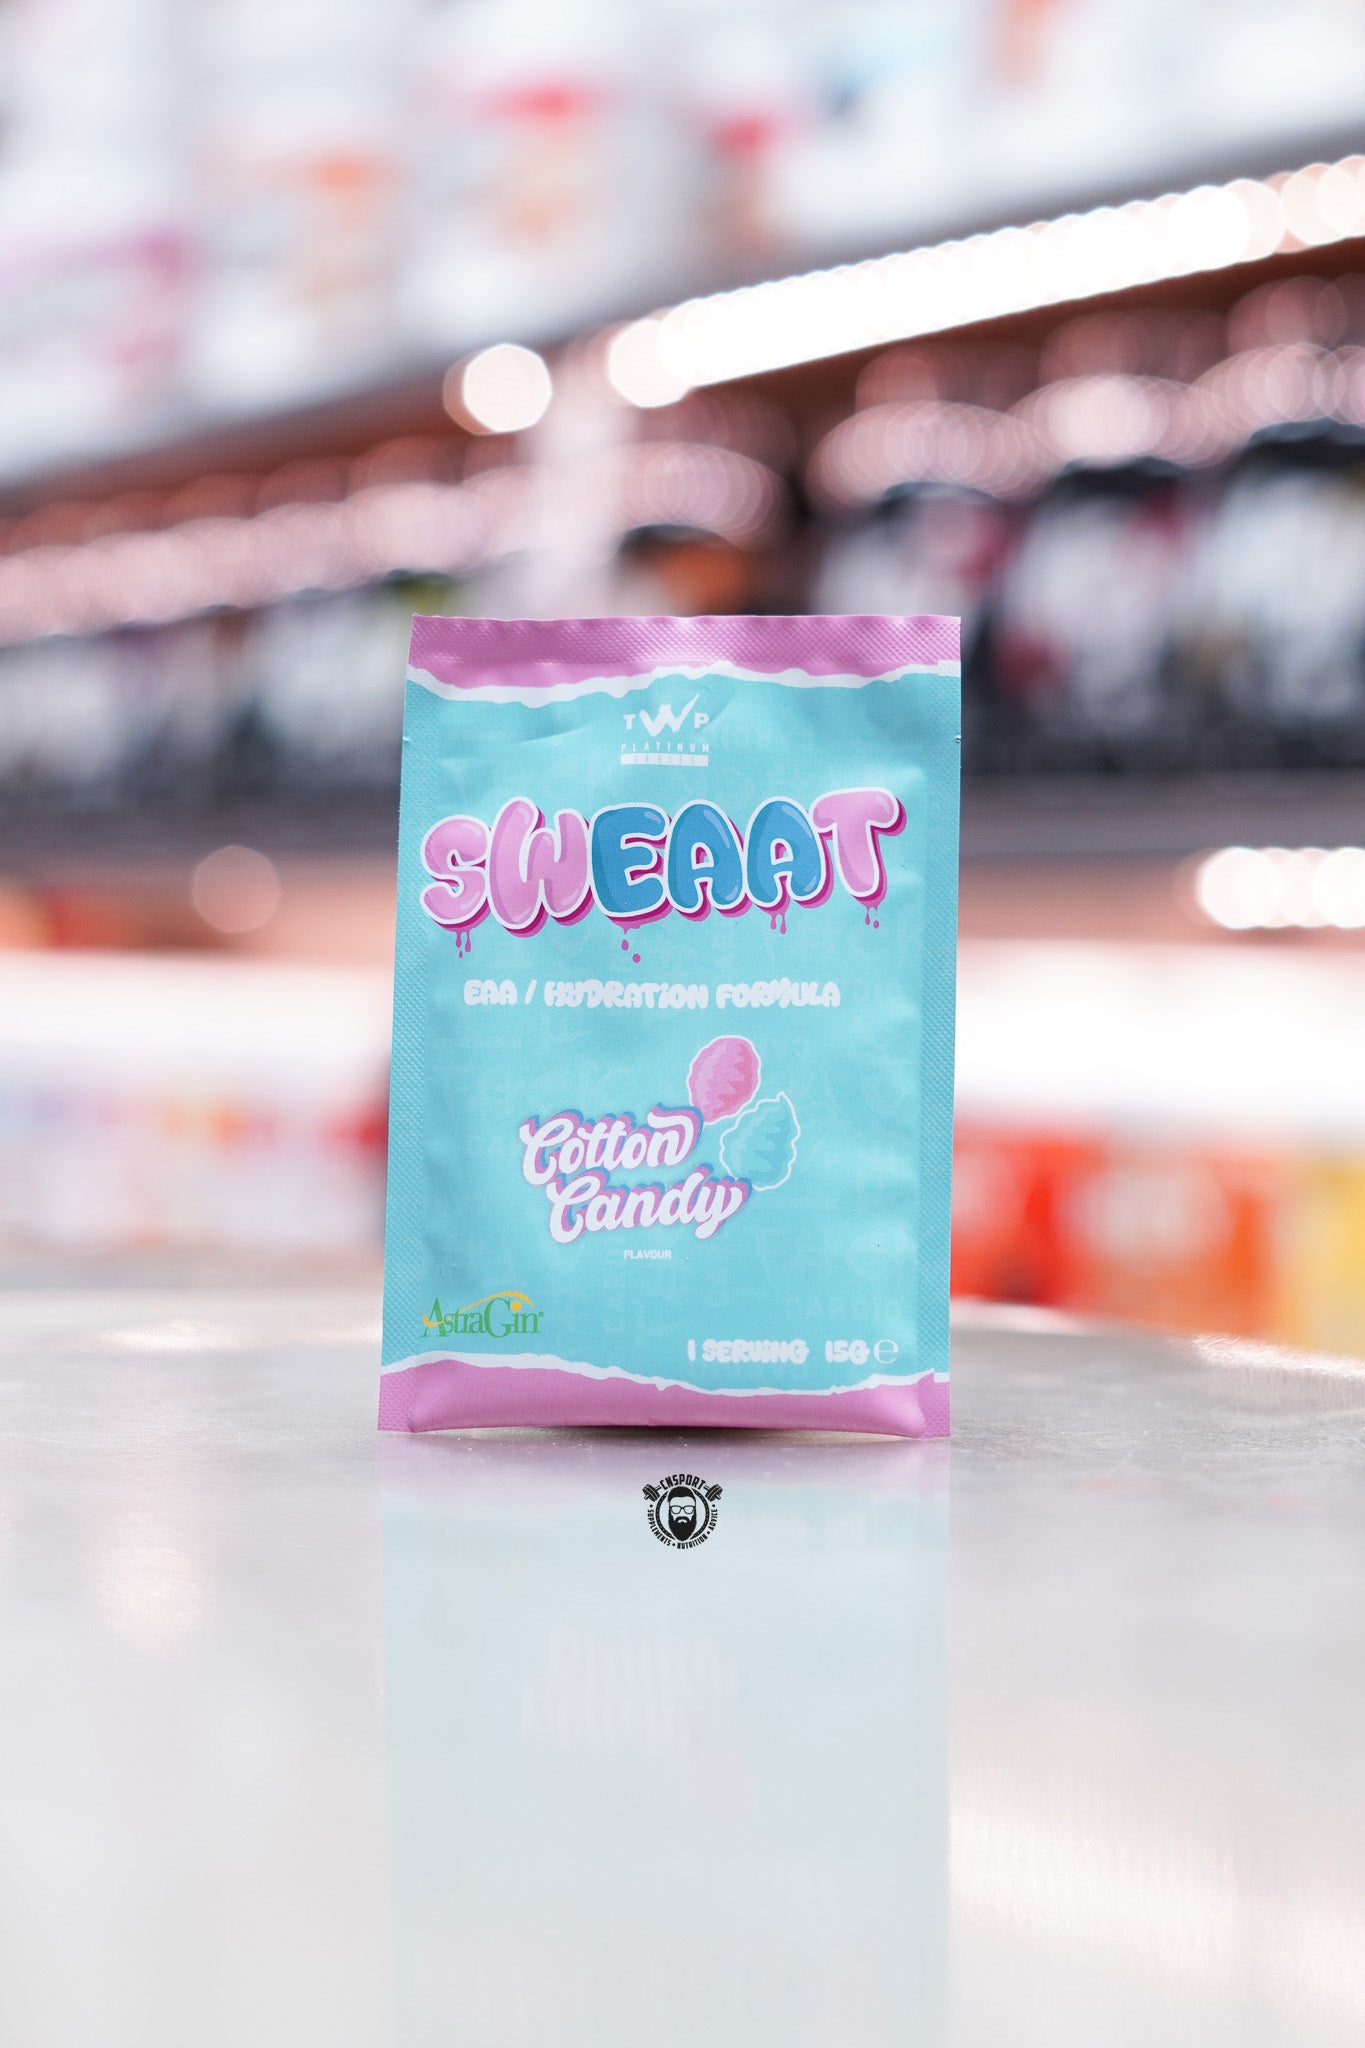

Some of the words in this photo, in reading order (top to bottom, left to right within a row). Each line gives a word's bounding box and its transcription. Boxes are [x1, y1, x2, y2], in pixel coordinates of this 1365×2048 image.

[623, 693, 709, 736] TWP
[620, 741, 709, 752] PLATINUM
[633, 754, 696, 764] SERIES
[421, 788, 906, 936] SWEAAT
[464, 979, 518, 1005] EAA
[525, 979, 537, 1004] /
[544, 979, 708, 1009] HYDRATION
[716, 977, 841, 1008] FORMULA
[518, 1102, 704, 1186] Cotton
[545, 1163, 752, 1244] Candy
[623, 1249, 672, 1260] FLAVOUR
[702, 1338, 809, 1364] SERVING
[825, 1339, 870, 1365] 15G
